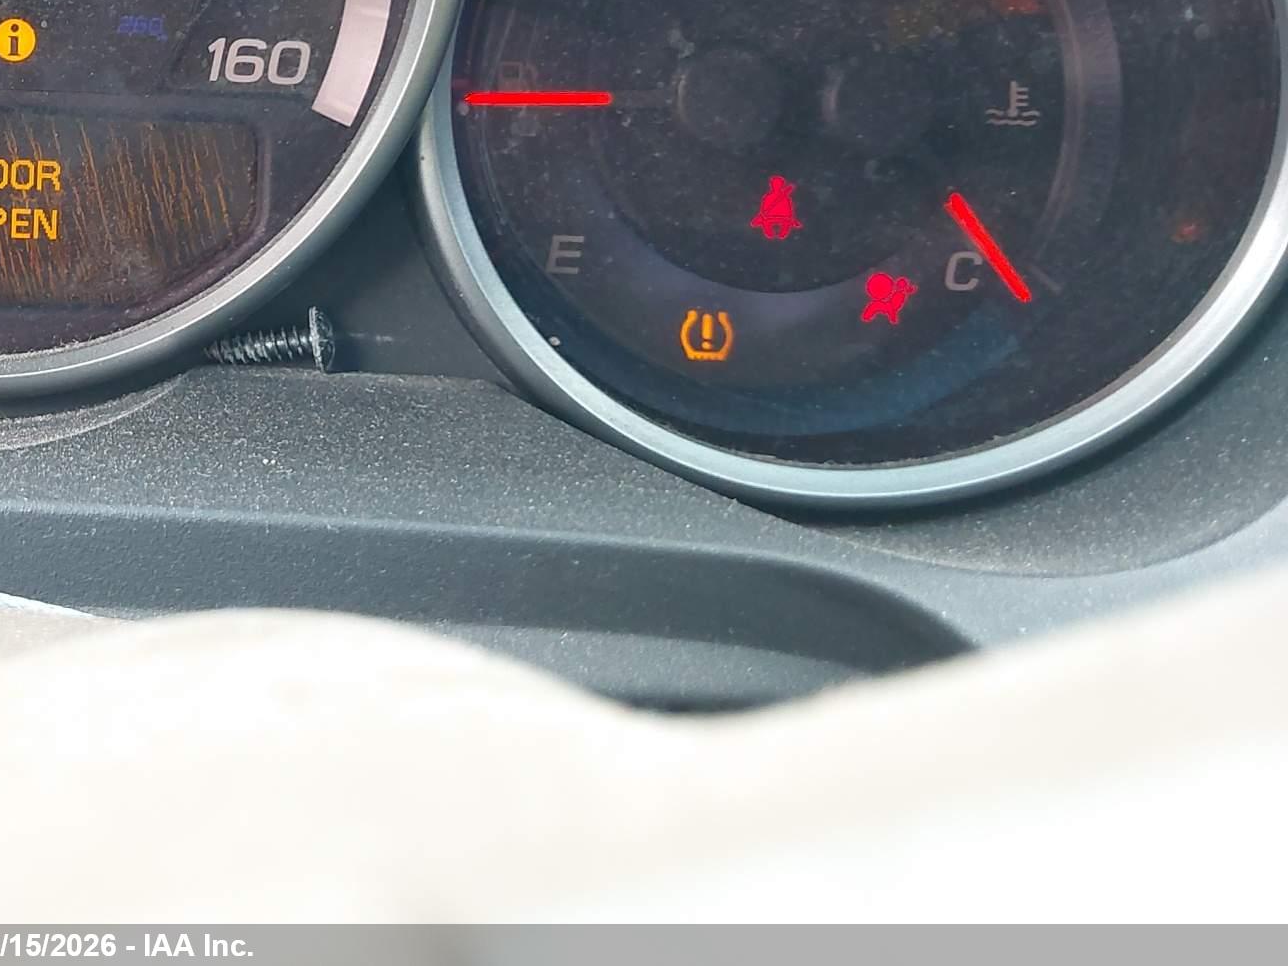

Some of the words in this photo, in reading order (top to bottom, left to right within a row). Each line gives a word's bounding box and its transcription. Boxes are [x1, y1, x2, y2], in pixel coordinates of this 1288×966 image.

[207, 37, 311, 85] 160
[545, 234, 585, 274] E
[945, 251, 983, 291] C
